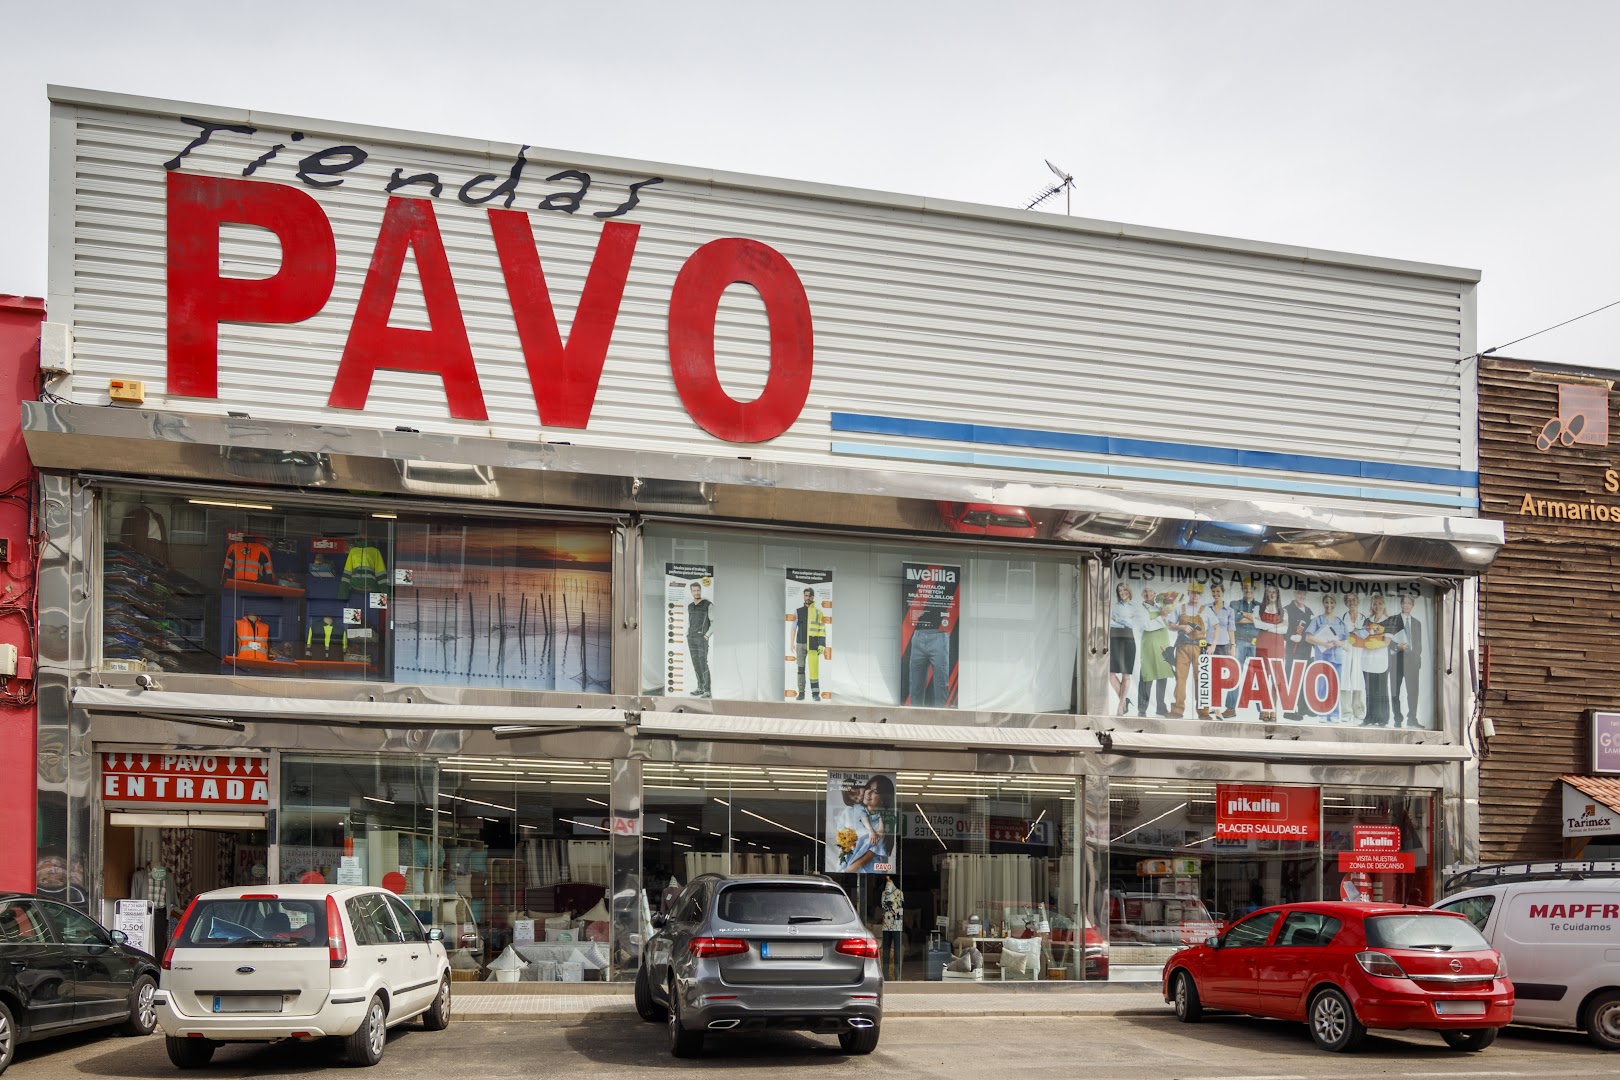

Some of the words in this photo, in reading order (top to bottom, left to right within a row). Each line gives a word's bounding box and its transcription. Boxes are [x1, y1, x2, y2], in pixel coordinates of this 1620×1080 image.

[164, 116, 663, 219] Tiendas
[166, 171, 815, 444] PAVO
[1519, 493, 1620, 524] Armarios
[909, 568, 956, 583] velilla
[1114, 561, 1224, 586] VESTIMOS
[1230, 569, 1244, 583] A
[1250, 571, 1421, 597] PROFESIONALES
[907, 592, 954, 600] MULTIBOLSILLOS
[1200, 656, 1209, 706] TIENDAS
[1211, 656, 1339, 713] PAVO
[164, 754, 218, 773] PAVO
[105, 775, 269, 801] ENTRADA
[1227, 797, 1280, 815] pikolin
[1217, 823, 1254, 833] PLACER
[1254, 824, 1308, 835] SALUDABLE
[1360, 836, 1393, 848] pikolin
[875, 863, 892, 871] PAVO
[1372, 855, 1398, 863] NUESTRA
[1529, 904, 1620, 919] MAPFR
[1550, 923, 1560, 931] Te
[1562, 922, 1611, 931] Cuidamos
